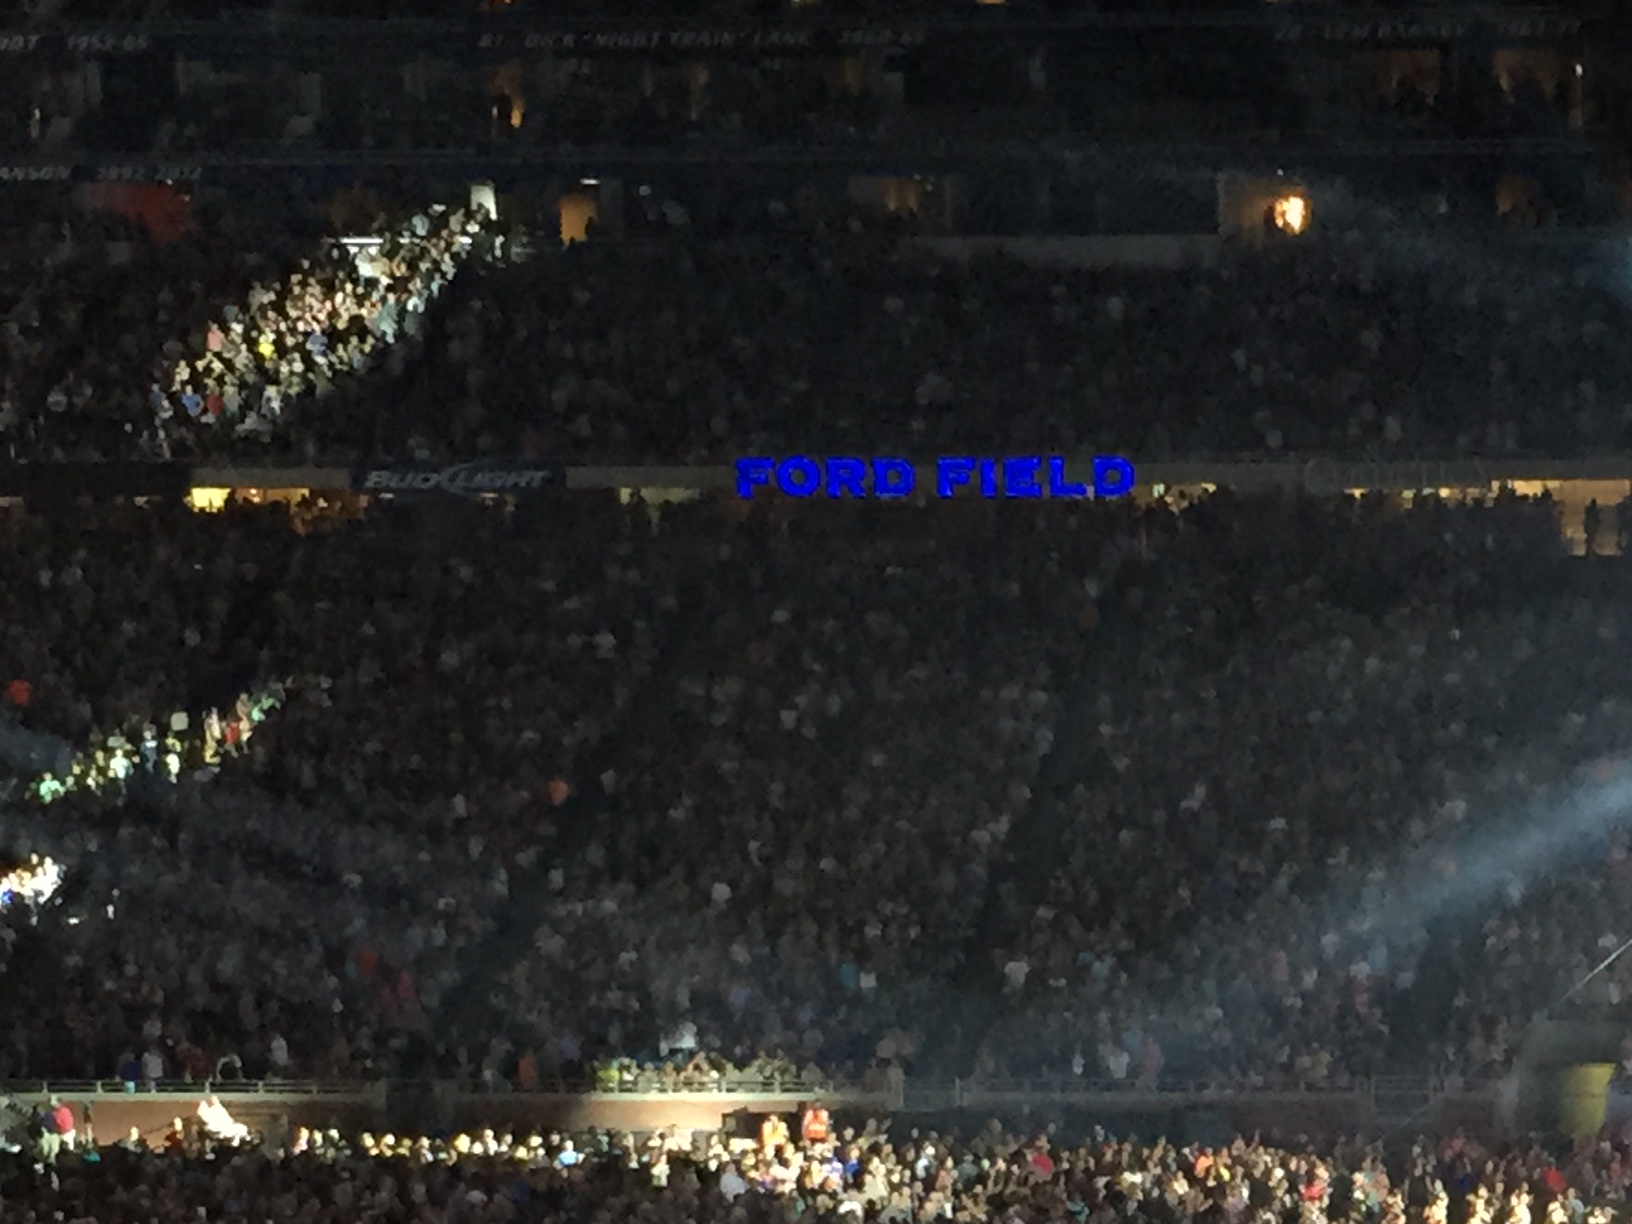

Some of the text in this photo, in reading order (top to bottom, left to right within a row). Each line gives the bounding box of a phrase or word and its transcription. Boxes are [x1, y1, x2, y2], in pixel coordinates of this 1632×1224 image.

[364, 469, 550, 489] BUD LIGHT
[734, 454, 1135, 499] FORD FIELD
